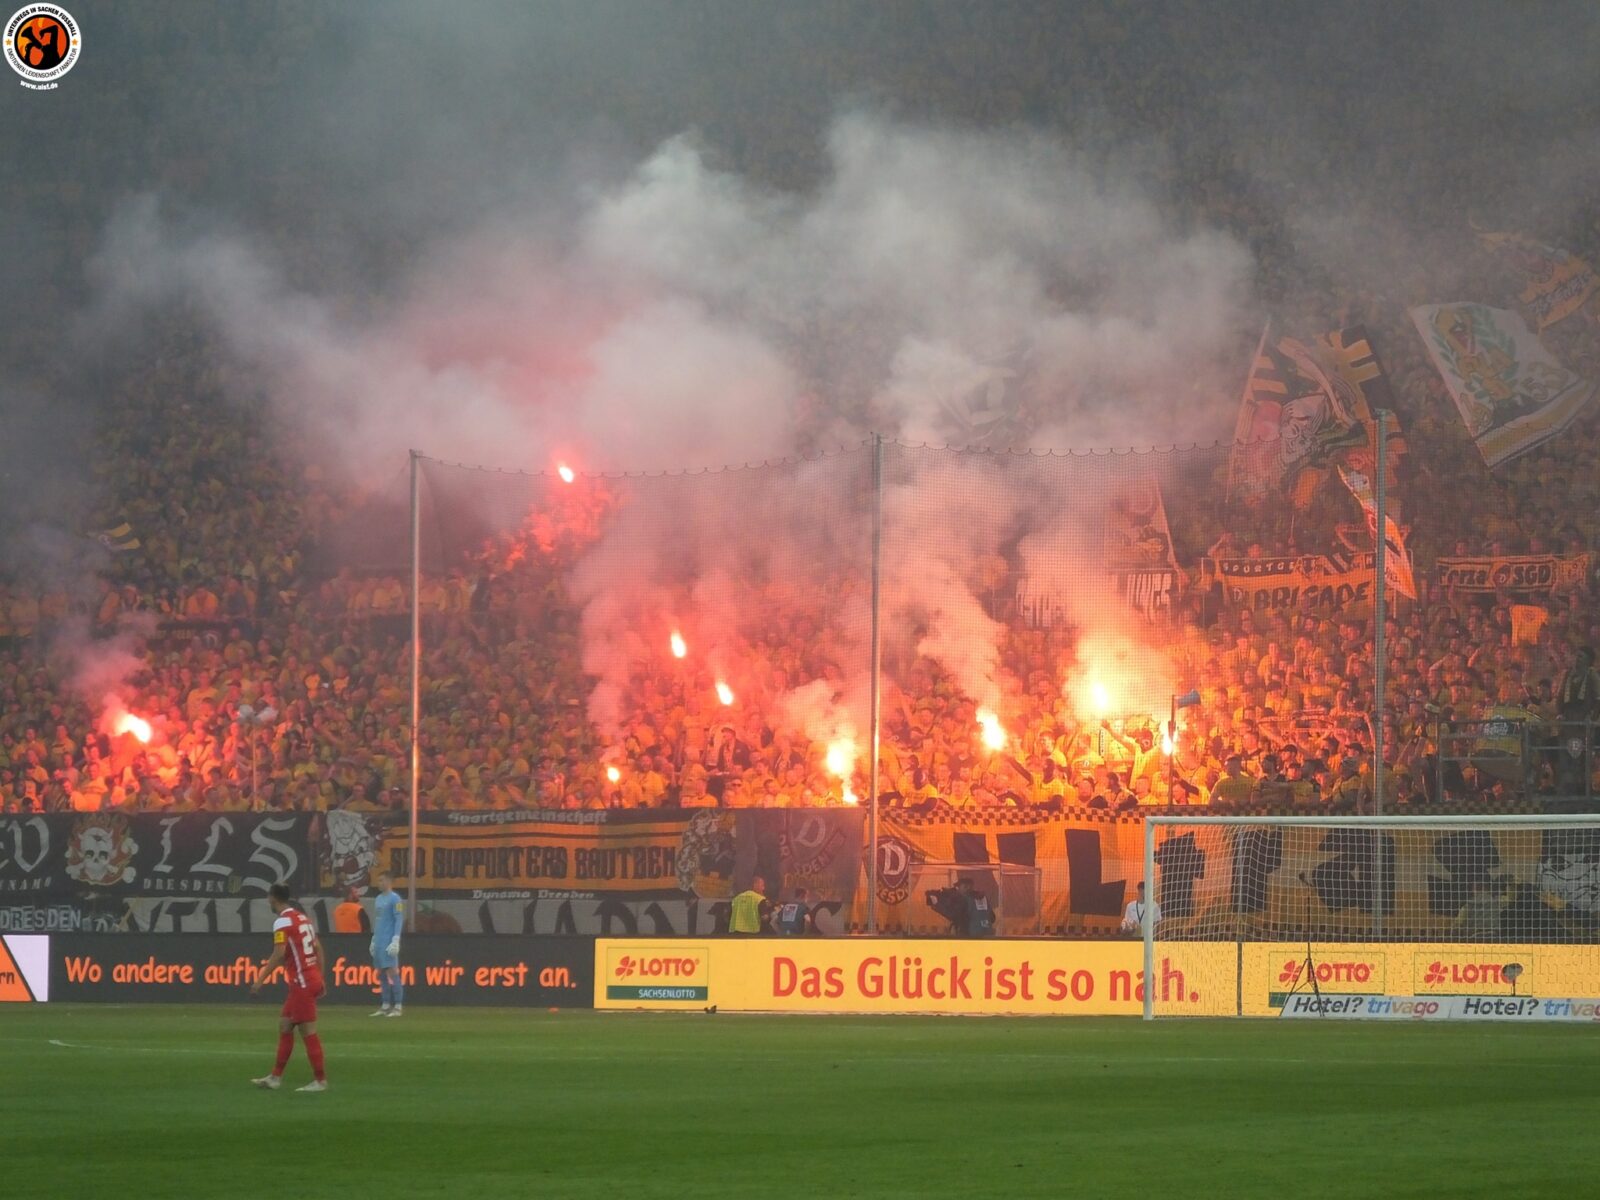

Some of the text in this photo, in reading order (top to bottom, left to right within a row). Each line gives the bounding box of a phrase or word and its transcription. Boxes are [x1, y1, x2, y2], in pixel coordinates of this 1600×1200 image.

[143, 878, 225, 892] DRESDEN
[473, 889, 594, 899] Dynamo Dresden
[0, 905, 81, 930] DRESDEN
[65, 956, 102, 983] Wo
[112, 956, 194, 984] andere
[205, 957, 290, 986] aufhör
[332, 956, 415, 994] fangn
[425, 959, 464, 986] wir
[475, 961, 528, 987] erst
[539, 966, 577, 989] an.
[639, 957, 697, 977] LOTTO
[1307, 962, 1371, 983] LOTTO
[773, 956, 844, 998] Das
[857, 955, 972, 1000] Glück
[984, 956, 1034, 1001] ist
[1046, 968, 1095, 1001] so
[638, 988, 696, 999] SACHSENLOTTO
[1293, 996, 1438, 1018] Hotel? trivago
[1463, 997, 1539, 1016] Hotel?
